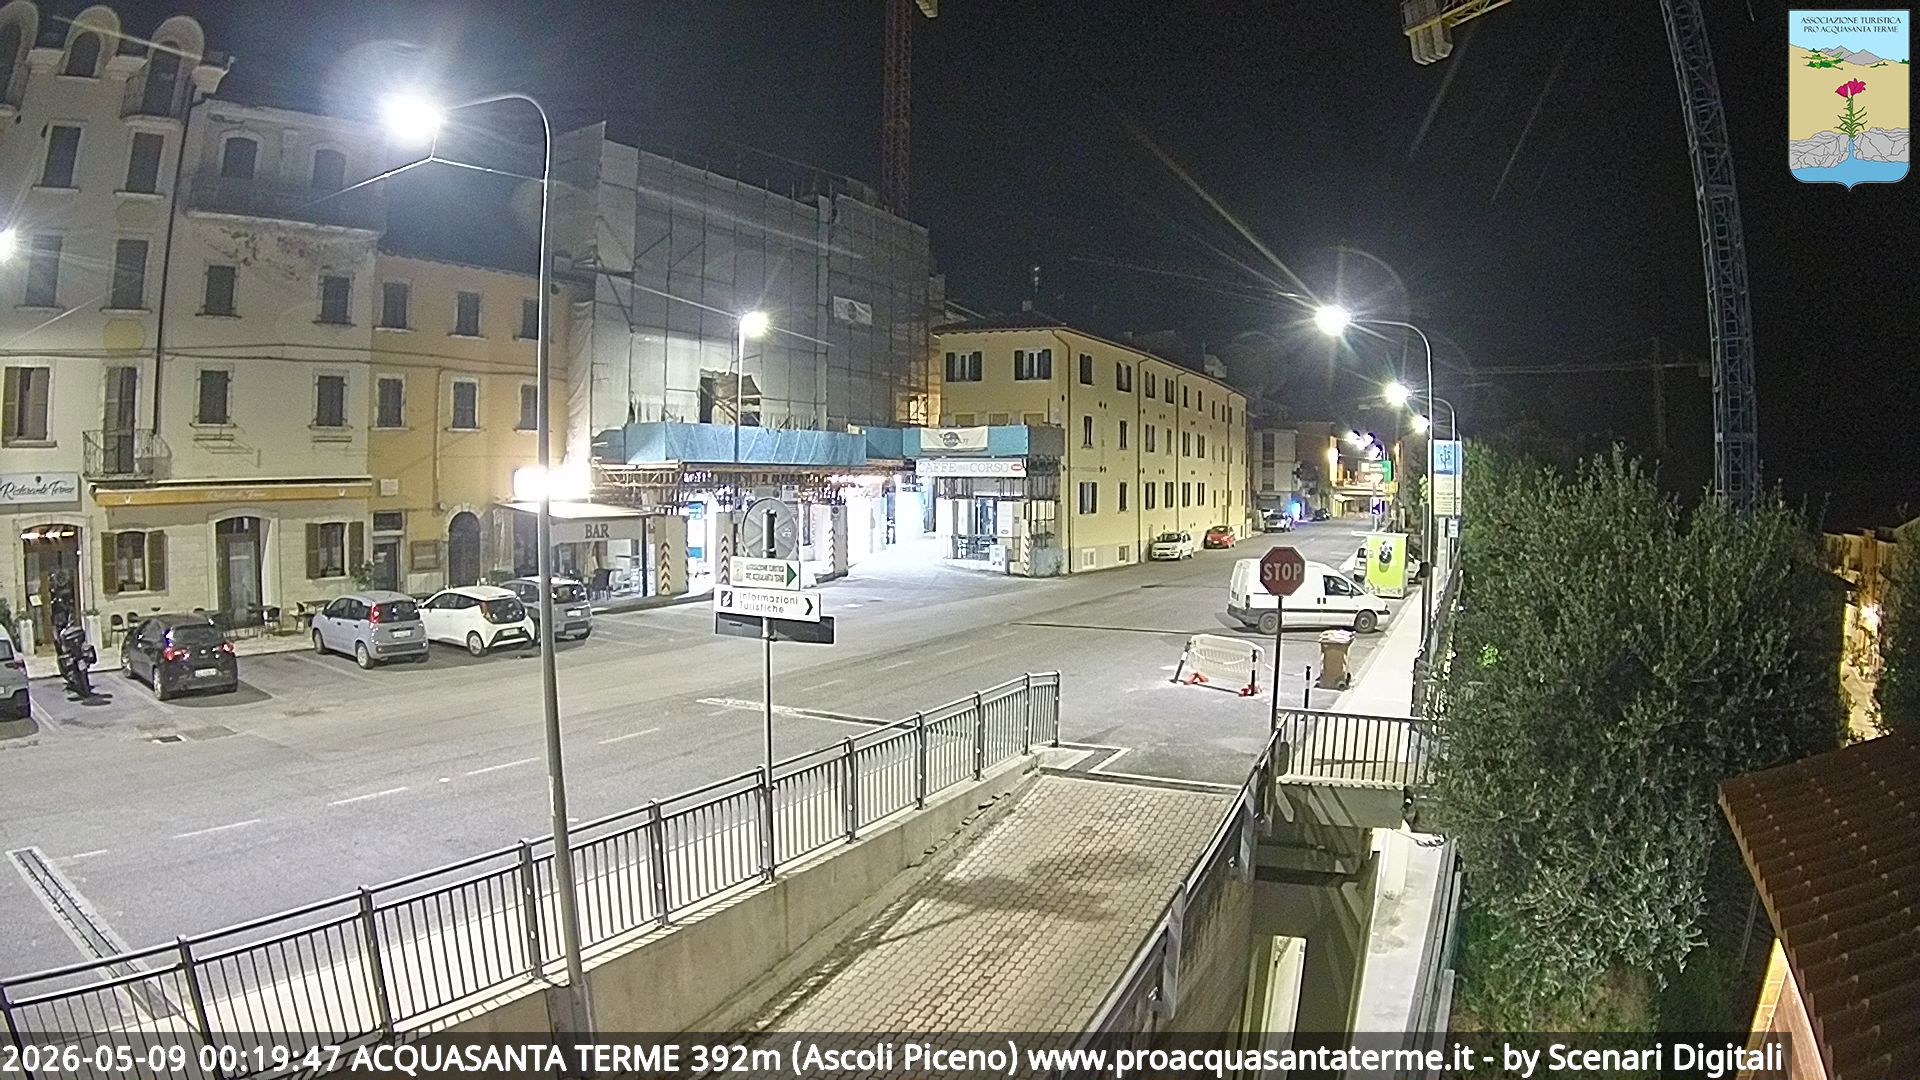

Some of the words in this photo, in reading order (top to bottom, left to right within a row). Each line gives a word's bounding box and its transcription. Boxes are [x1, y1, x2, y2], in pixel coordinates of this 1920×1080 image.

[969, 462, 1009, 473] CORSO
[585, 523, 610, 539] BAR
[1263, 562, 1303, 581] STOP
[740, 592, 798, 606] Informazioni
[740, 602, 784, 614] Turistiche
